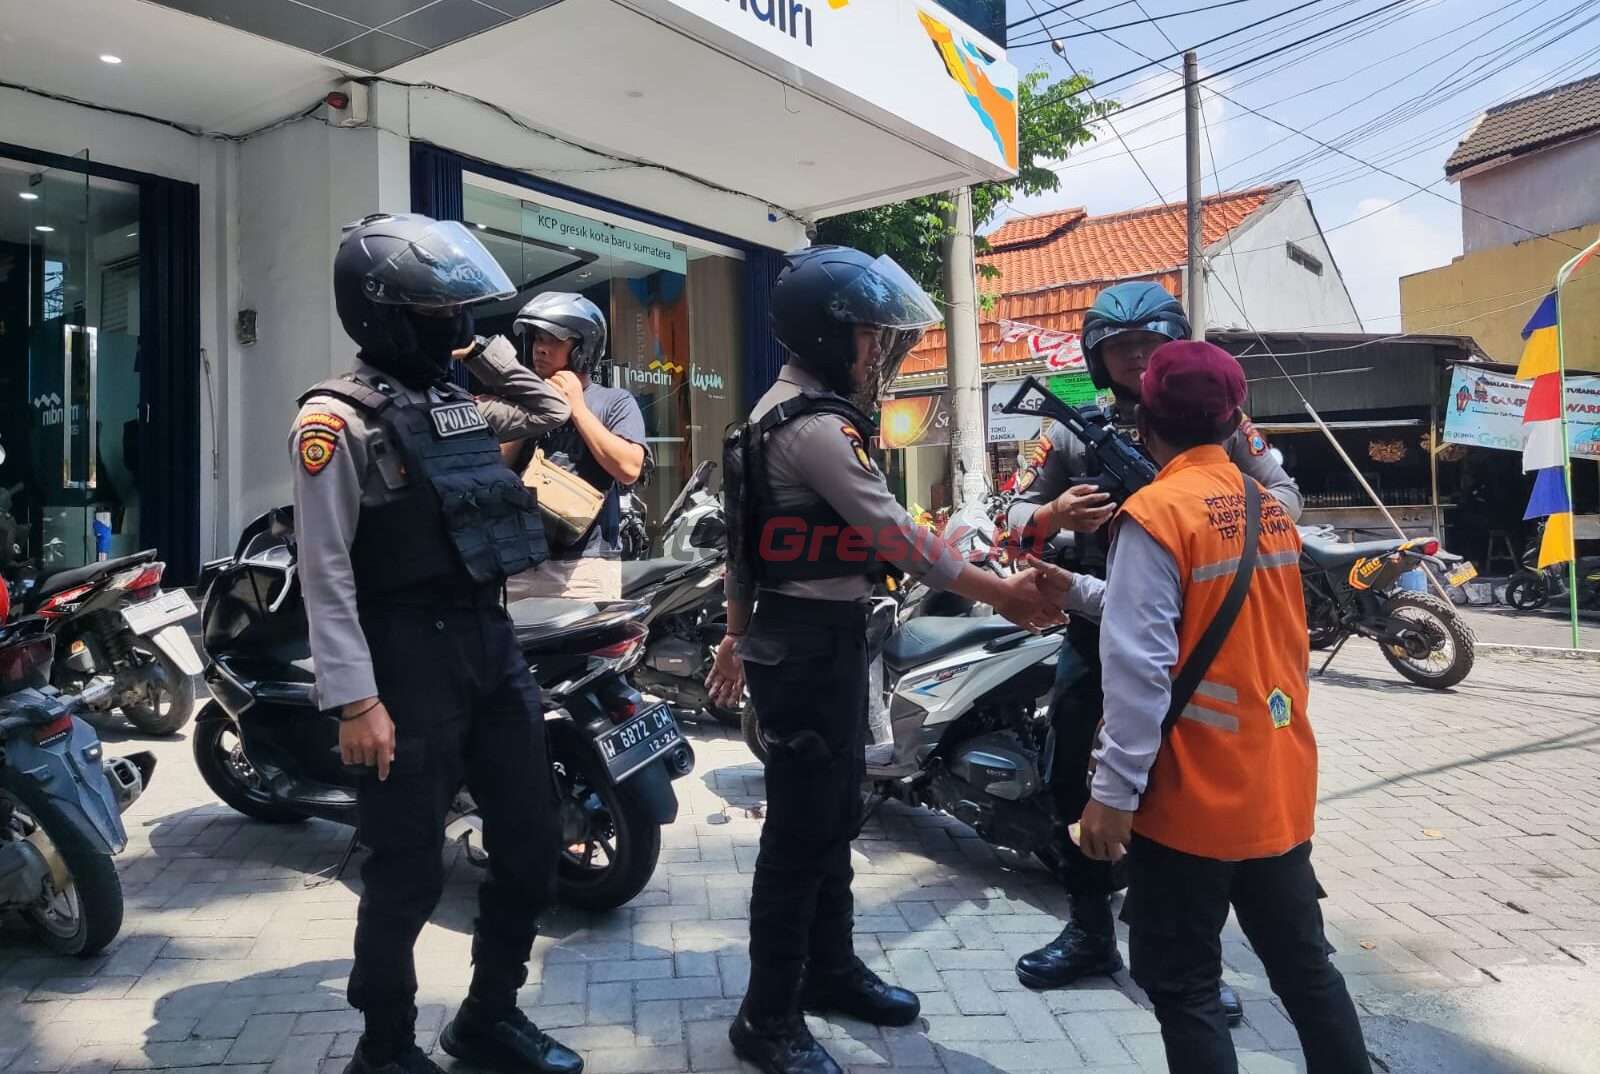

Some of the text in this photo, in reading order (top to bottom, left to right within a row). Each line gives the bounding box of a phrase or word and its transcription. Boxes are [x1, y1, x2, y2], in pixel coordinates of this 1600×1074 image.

[538, 215, 672, 260] KCP gresik kota baru sumatera
[691, 362, 723, 391] livin
[435, 406, 485, 431] POLISI
[603, 739, 616, 757] W
[620, 720, 650, 748] 6872
